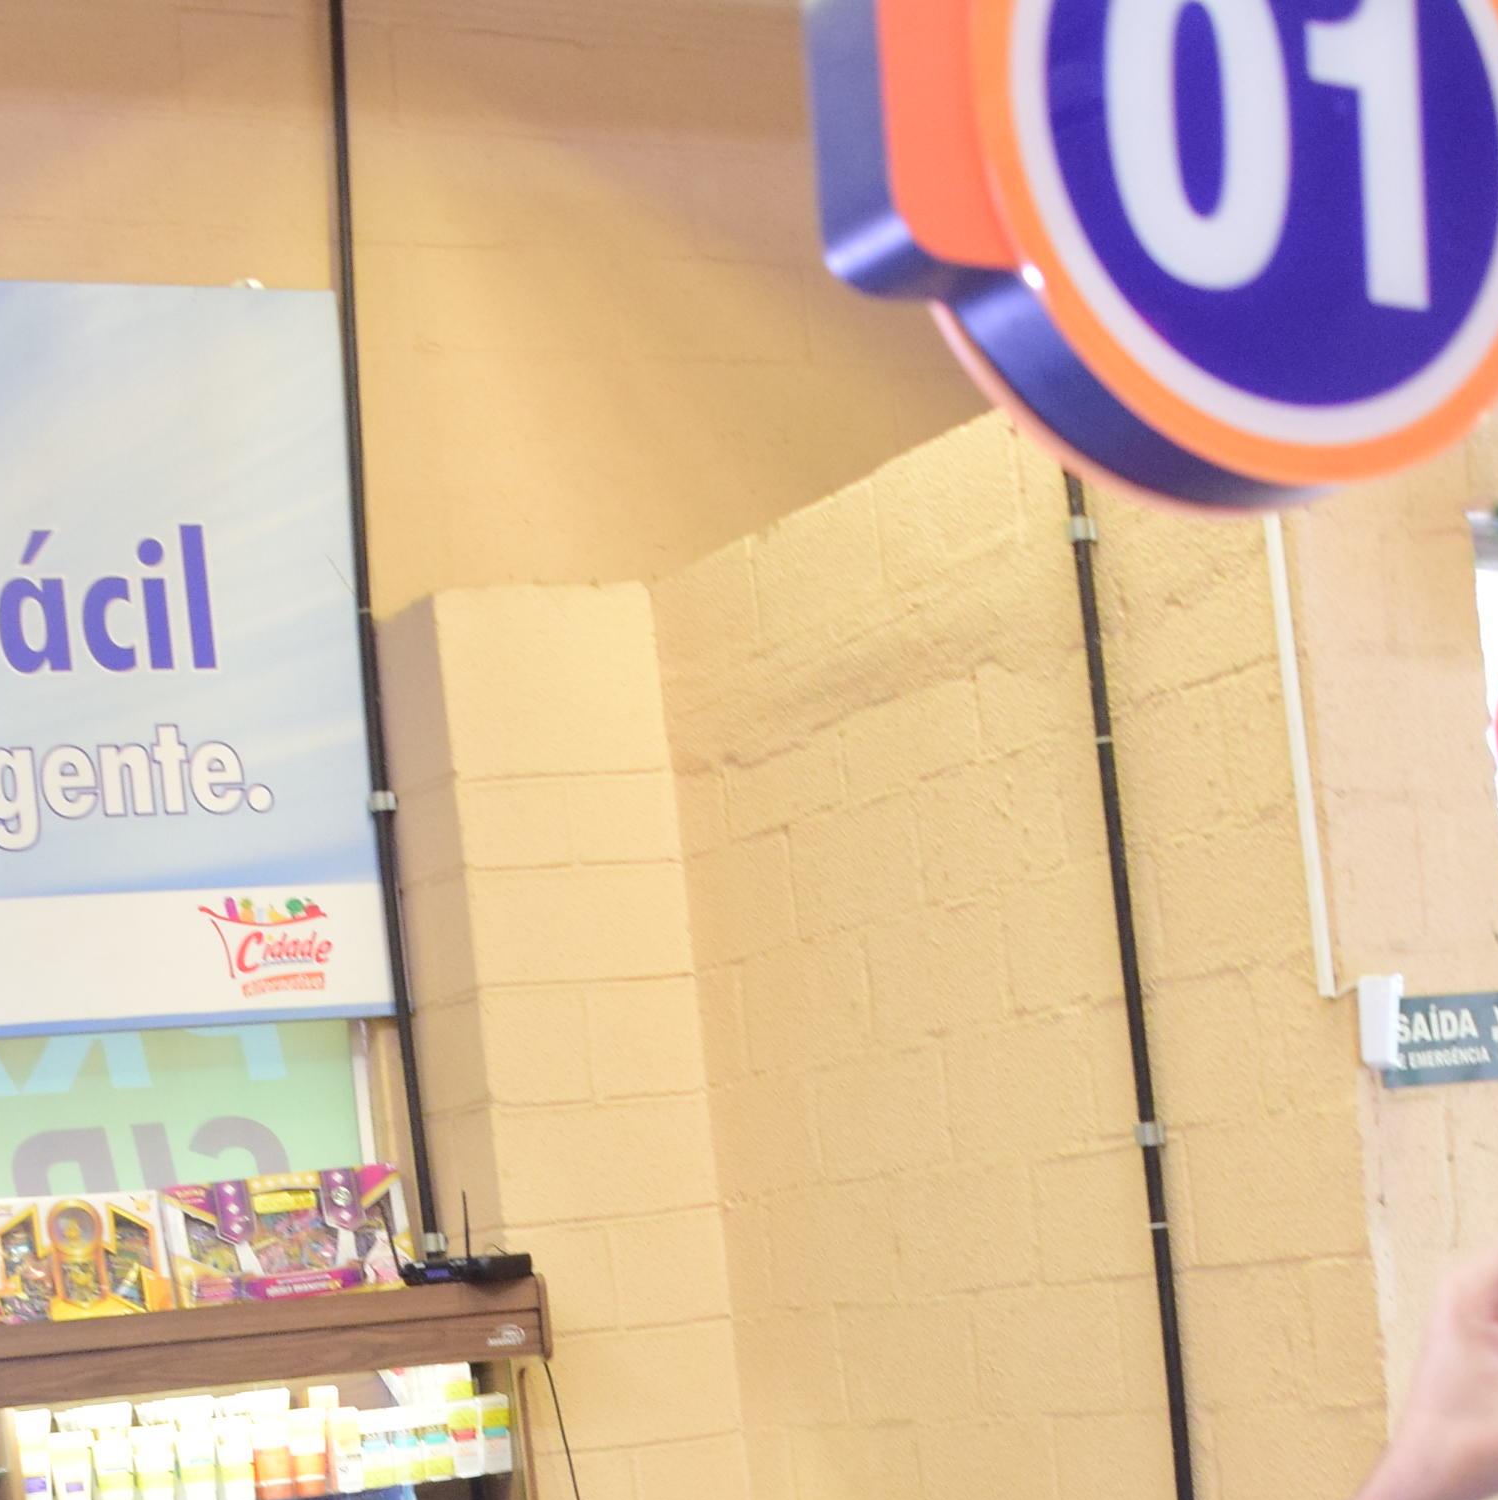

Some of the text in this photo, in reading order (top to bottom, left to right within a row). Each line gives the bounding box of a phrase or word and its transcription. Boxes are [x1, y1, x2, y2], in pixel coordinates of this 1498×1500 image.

[1105, 0, 1431, 311] 01
[236, 930, 333, 974] Cidade
[1397, 1003, 1479, 1045] SAÍDA
